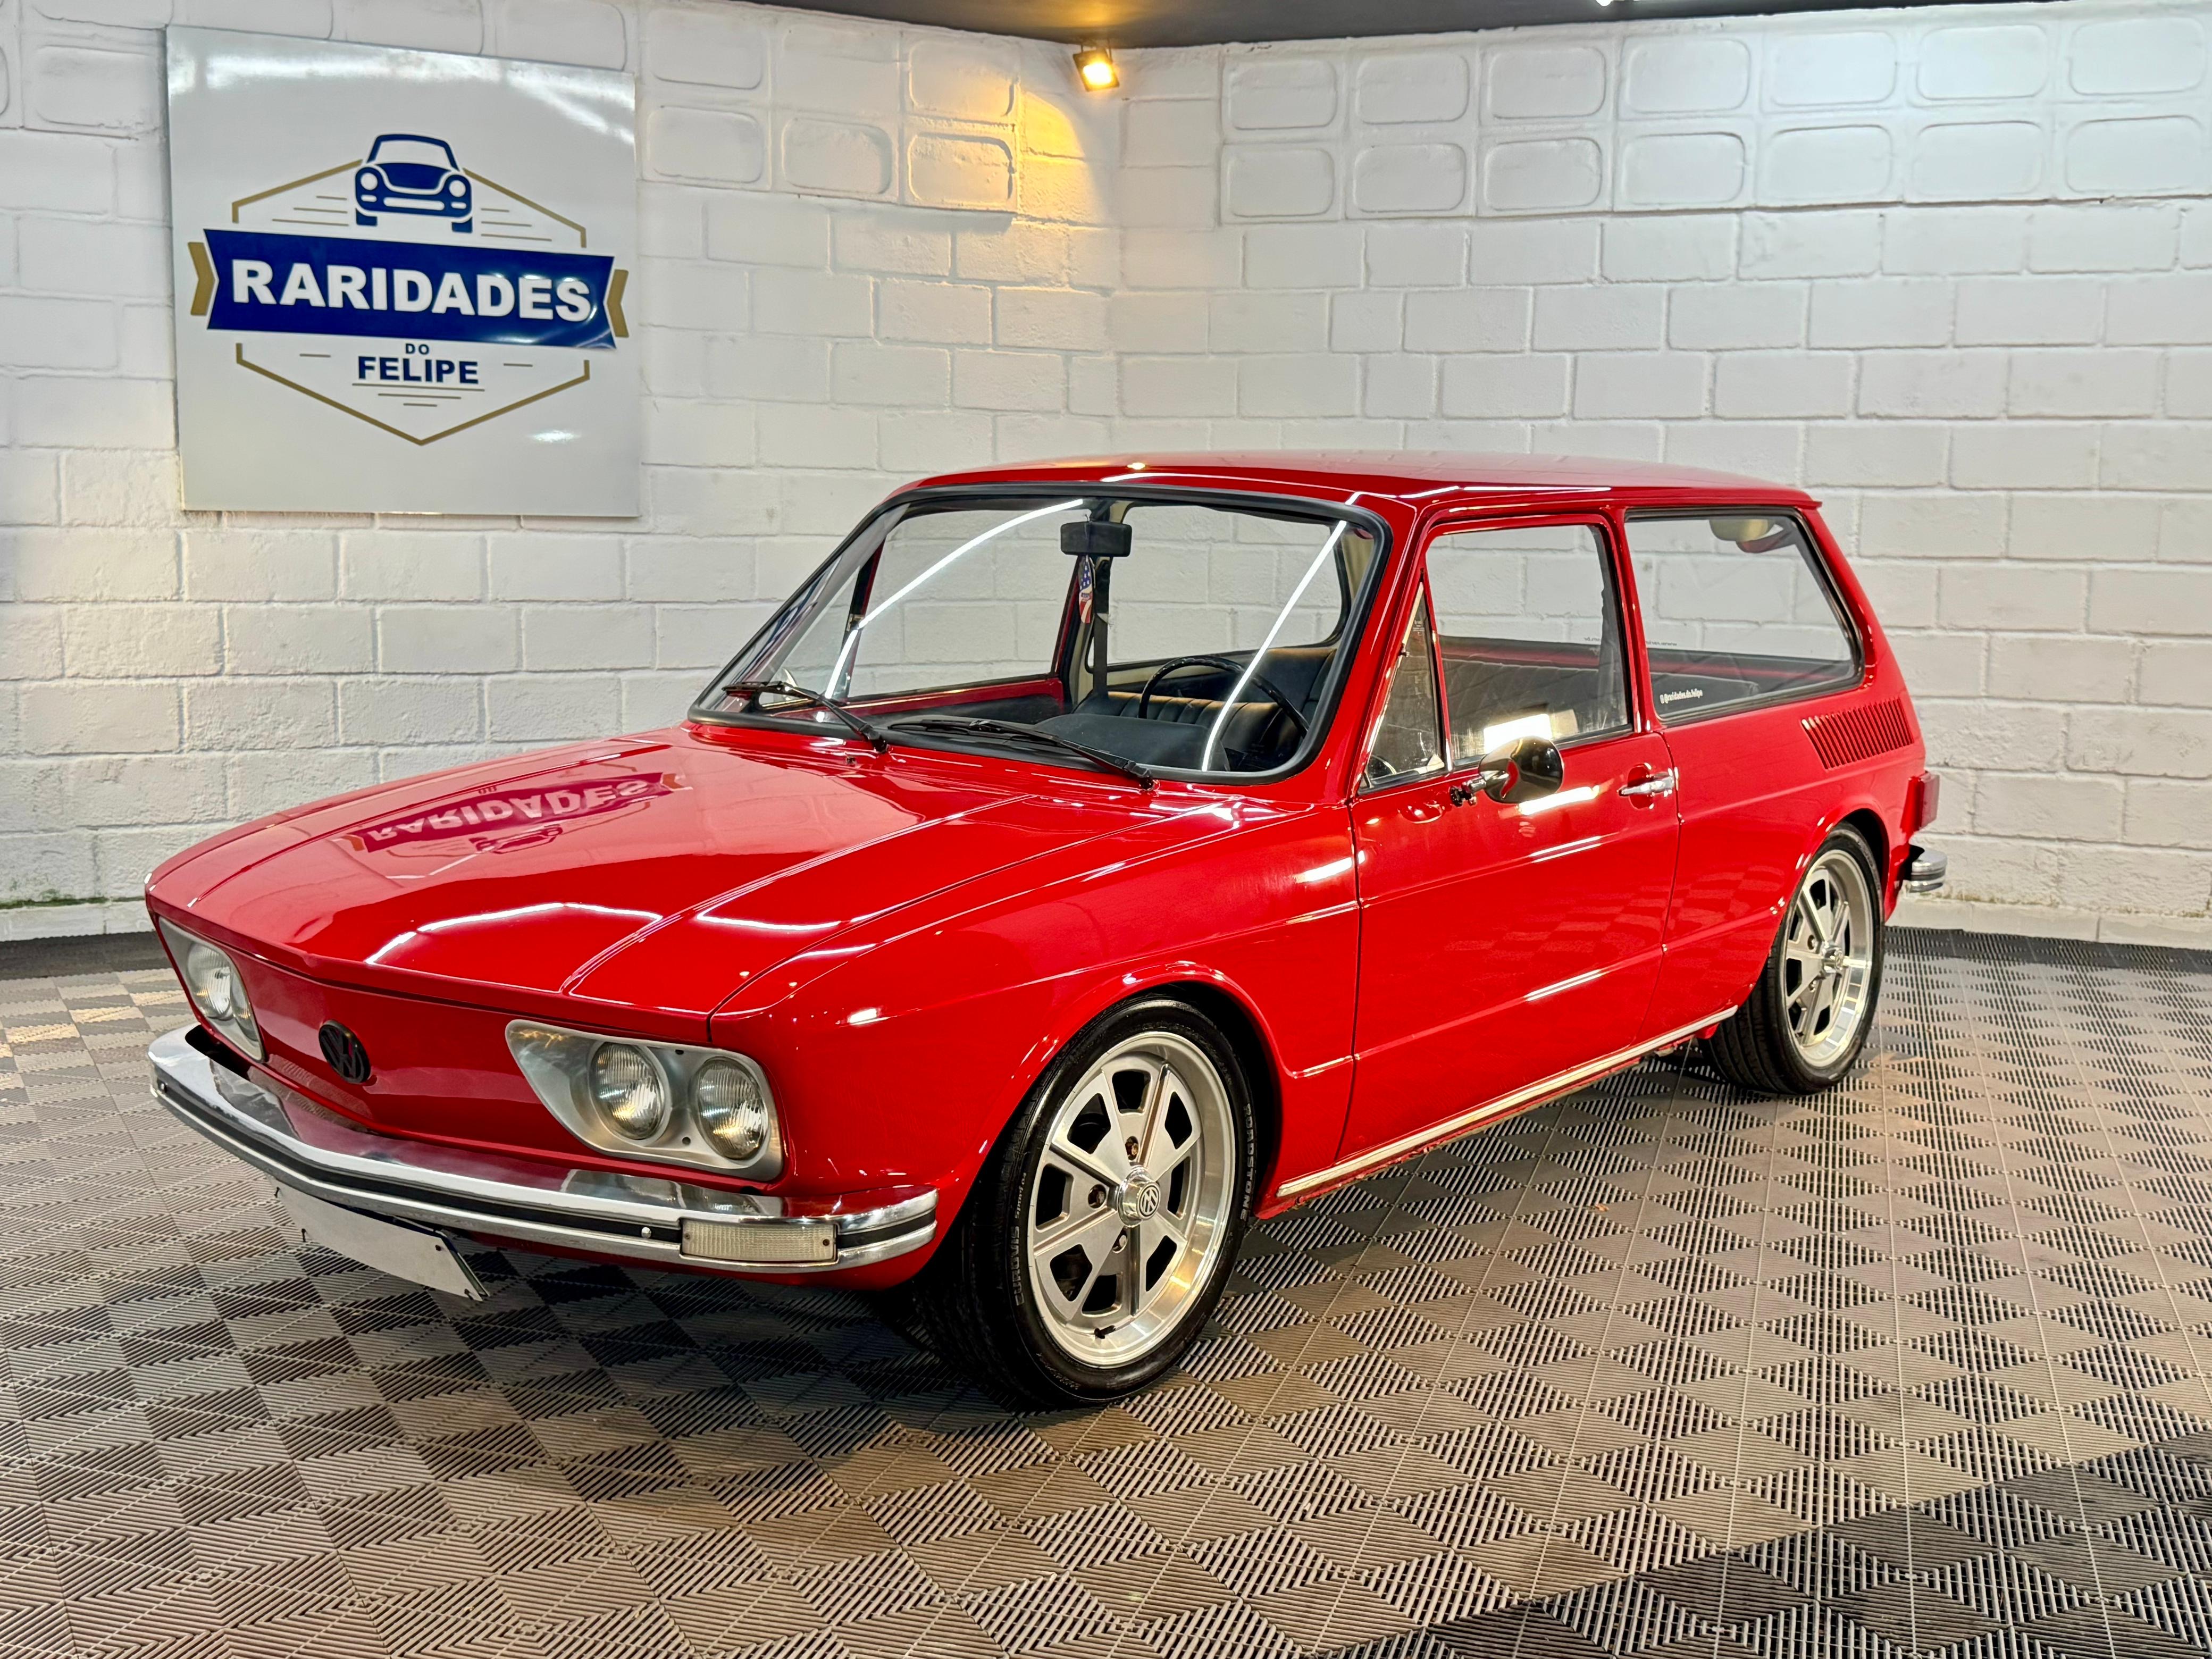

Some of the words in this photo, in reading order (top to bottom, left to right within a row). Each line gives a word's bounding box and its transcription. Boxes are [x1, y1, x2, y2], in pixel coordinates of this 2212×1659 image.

[231, 259, 593, 322] RARIDADES
[358, 356, 479, 384] FELIPE
[405, 343, 430, 355] DO
[1240, 1103, 1254, 1221] ROADSTONE
